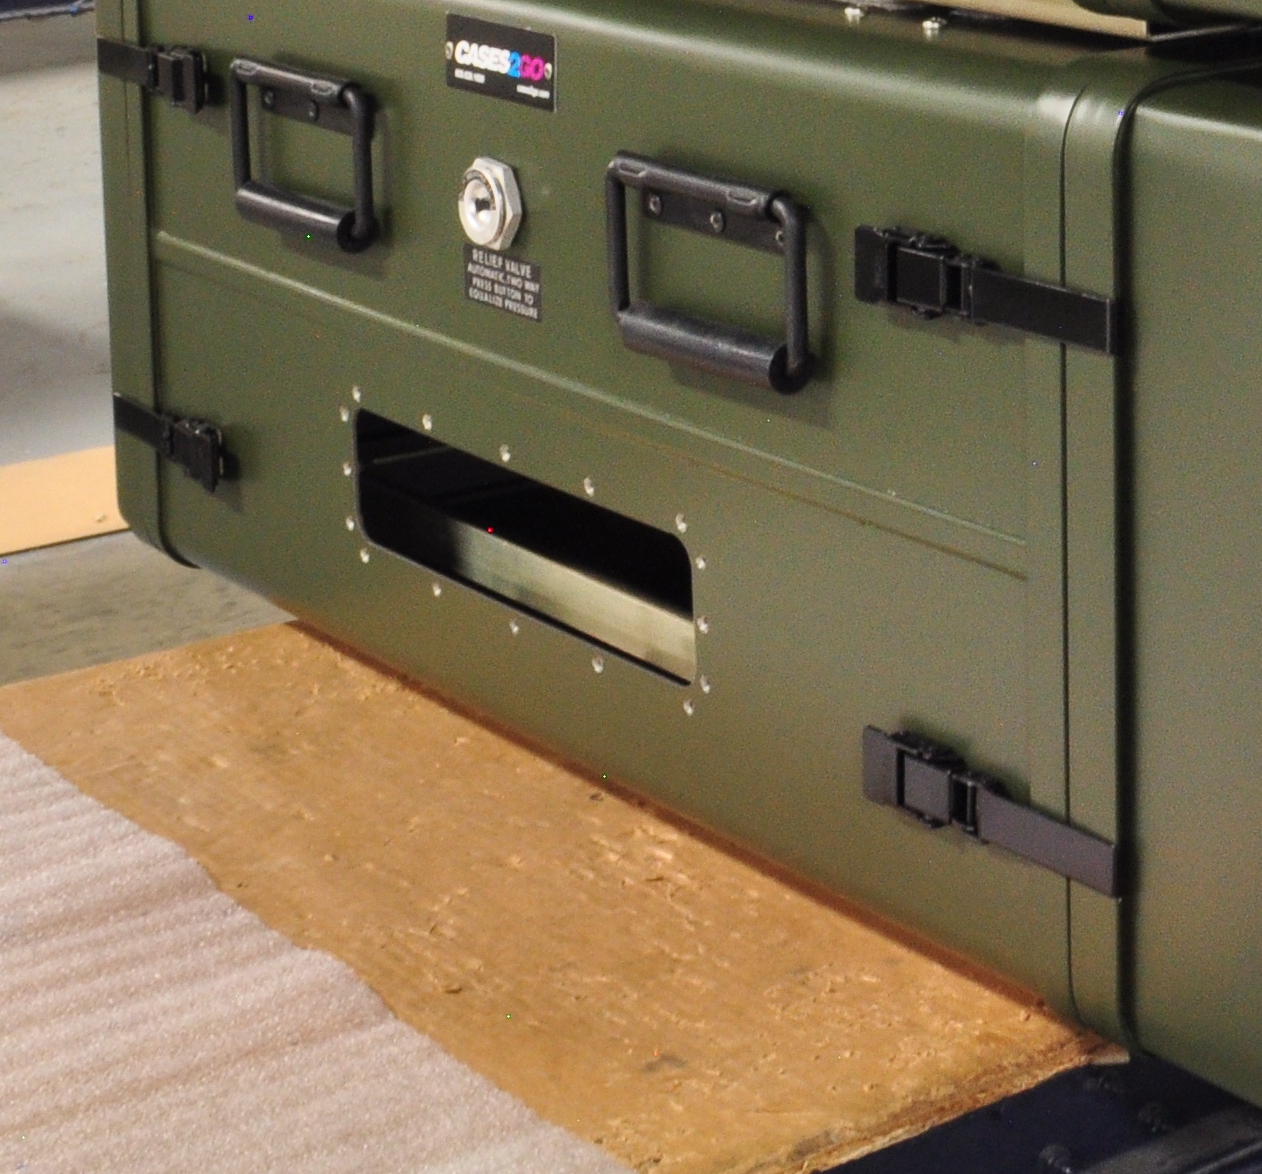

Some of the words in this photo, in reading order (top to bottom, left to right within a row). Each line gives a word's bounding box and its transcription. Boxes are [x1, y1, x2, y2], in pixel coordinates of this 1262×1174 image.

[455, 40, 544, 81] CASES2GO
[472, 248, 503, 268] RELIEF
[504, 258, 532, 279] VALVE
[472, 276, 492, 292] PRESS
[523, 292, 534, 306] TO
[504, 298, 539, 320] PRESSURE
